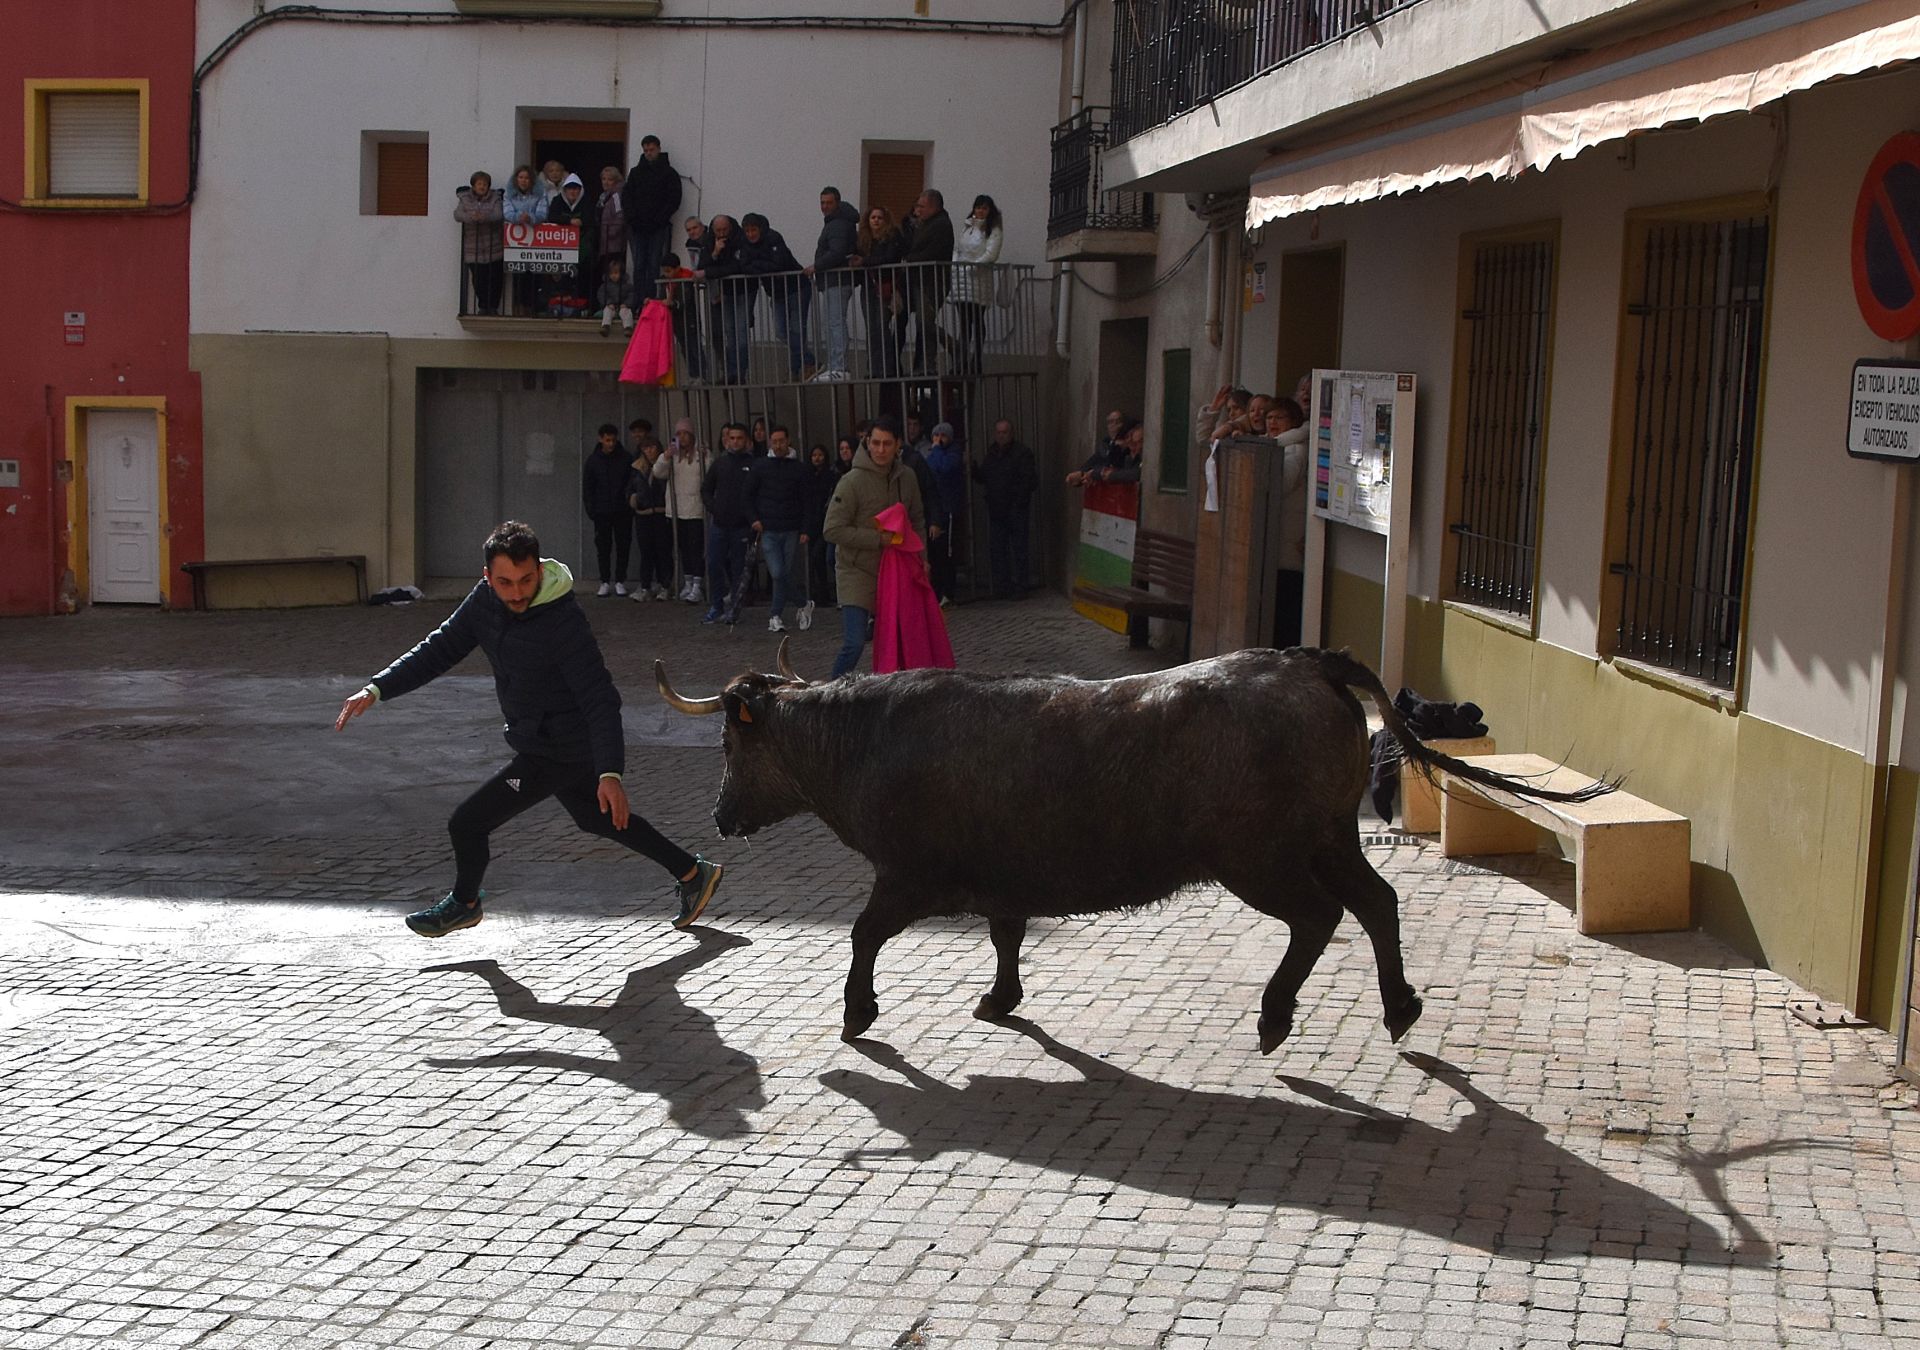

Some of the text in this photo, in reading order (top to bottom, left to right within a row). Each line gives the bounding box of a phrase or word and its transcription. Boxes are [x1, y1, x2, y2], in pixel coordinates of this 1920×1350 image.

[536, 228, 576, 244] queija
[520, 251, 563, 260] en venta
[507, 262, 526, 272] 941
[529, 262, 543, 272] 39
[545, 263, 559, 273] 09
[1858, 374, 1920, 395] EN TODA LA PLAZA
[1854, 400, 1920, 423] EXCEPTO VEHICULOS
[1863, 428, 1908, 449] AUTORIZADOS
